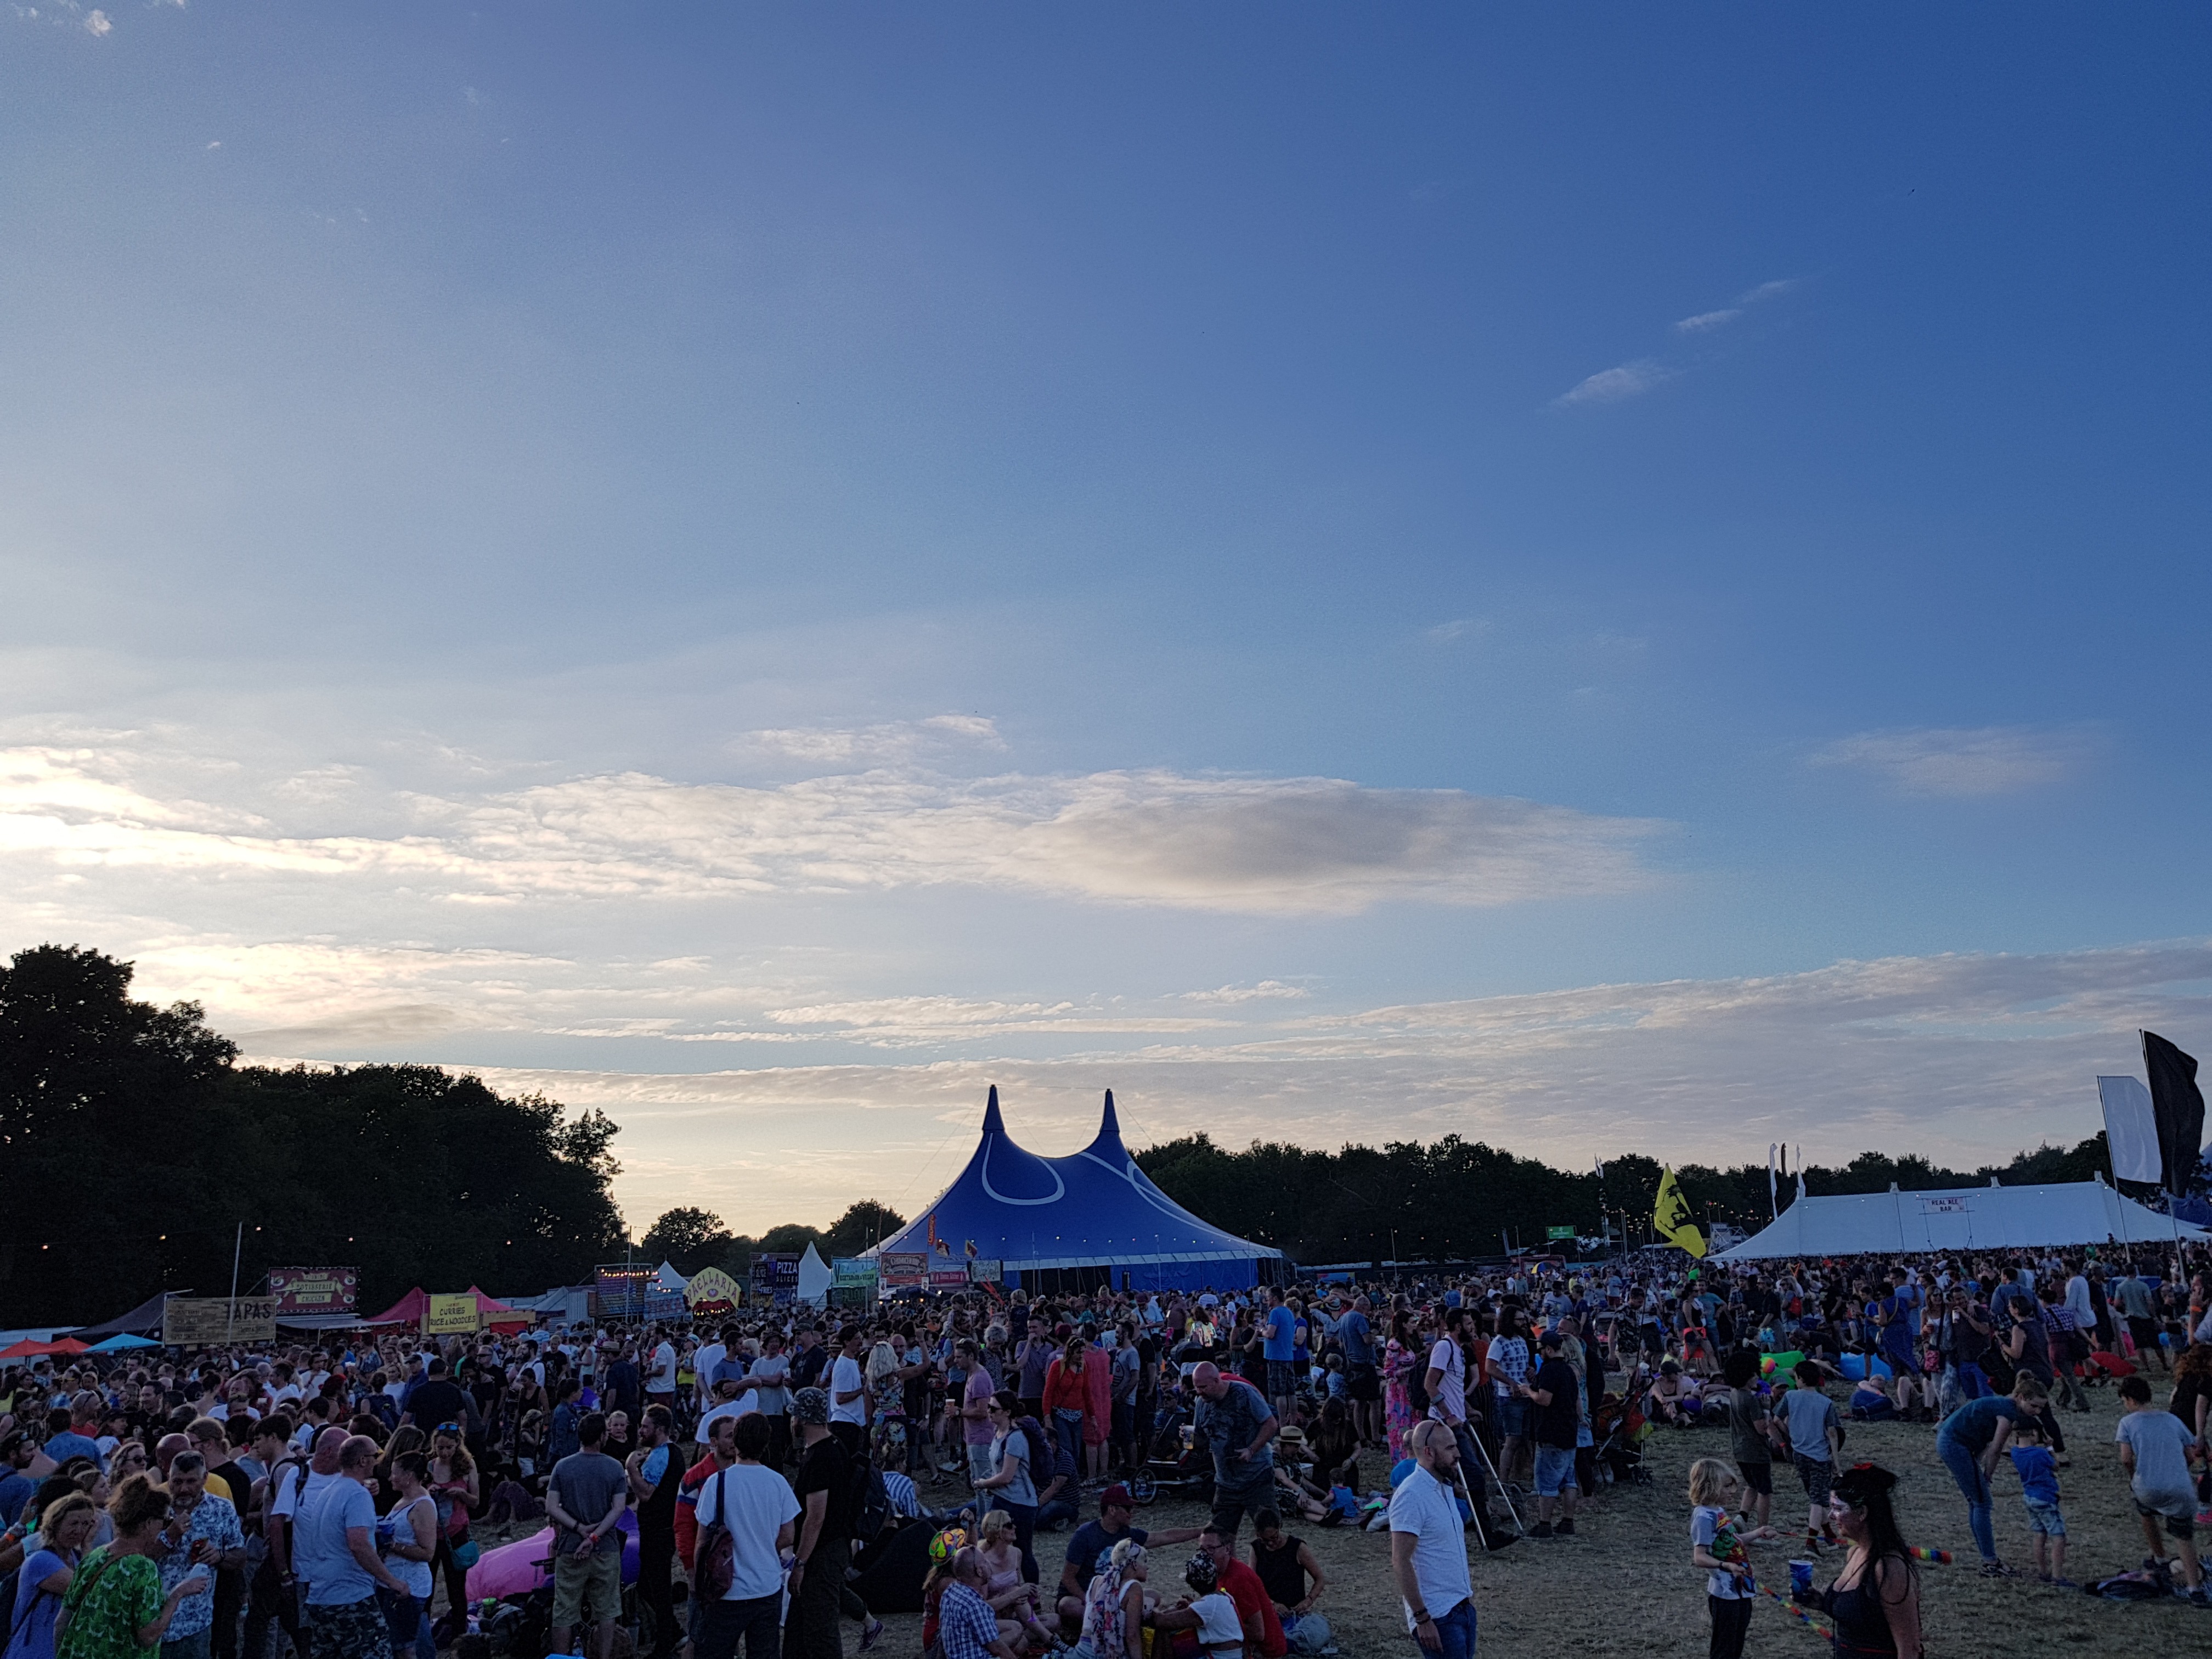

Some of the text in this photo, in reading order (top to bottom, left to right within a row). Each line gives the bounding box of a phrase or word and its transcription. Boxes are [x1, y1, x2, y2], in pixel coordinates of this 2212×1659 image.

[777, 1262, 798, 1274] PIZZA
[687, 1271, 737, 1301] PAELLARIA
[224, 1302, 270, 1320] TAPAS
[439, 1307, 465, 1316] CURRIES
[430, 1318, 444, 1326] RICE
[449, 1316, 476, 1325] NOODLES
